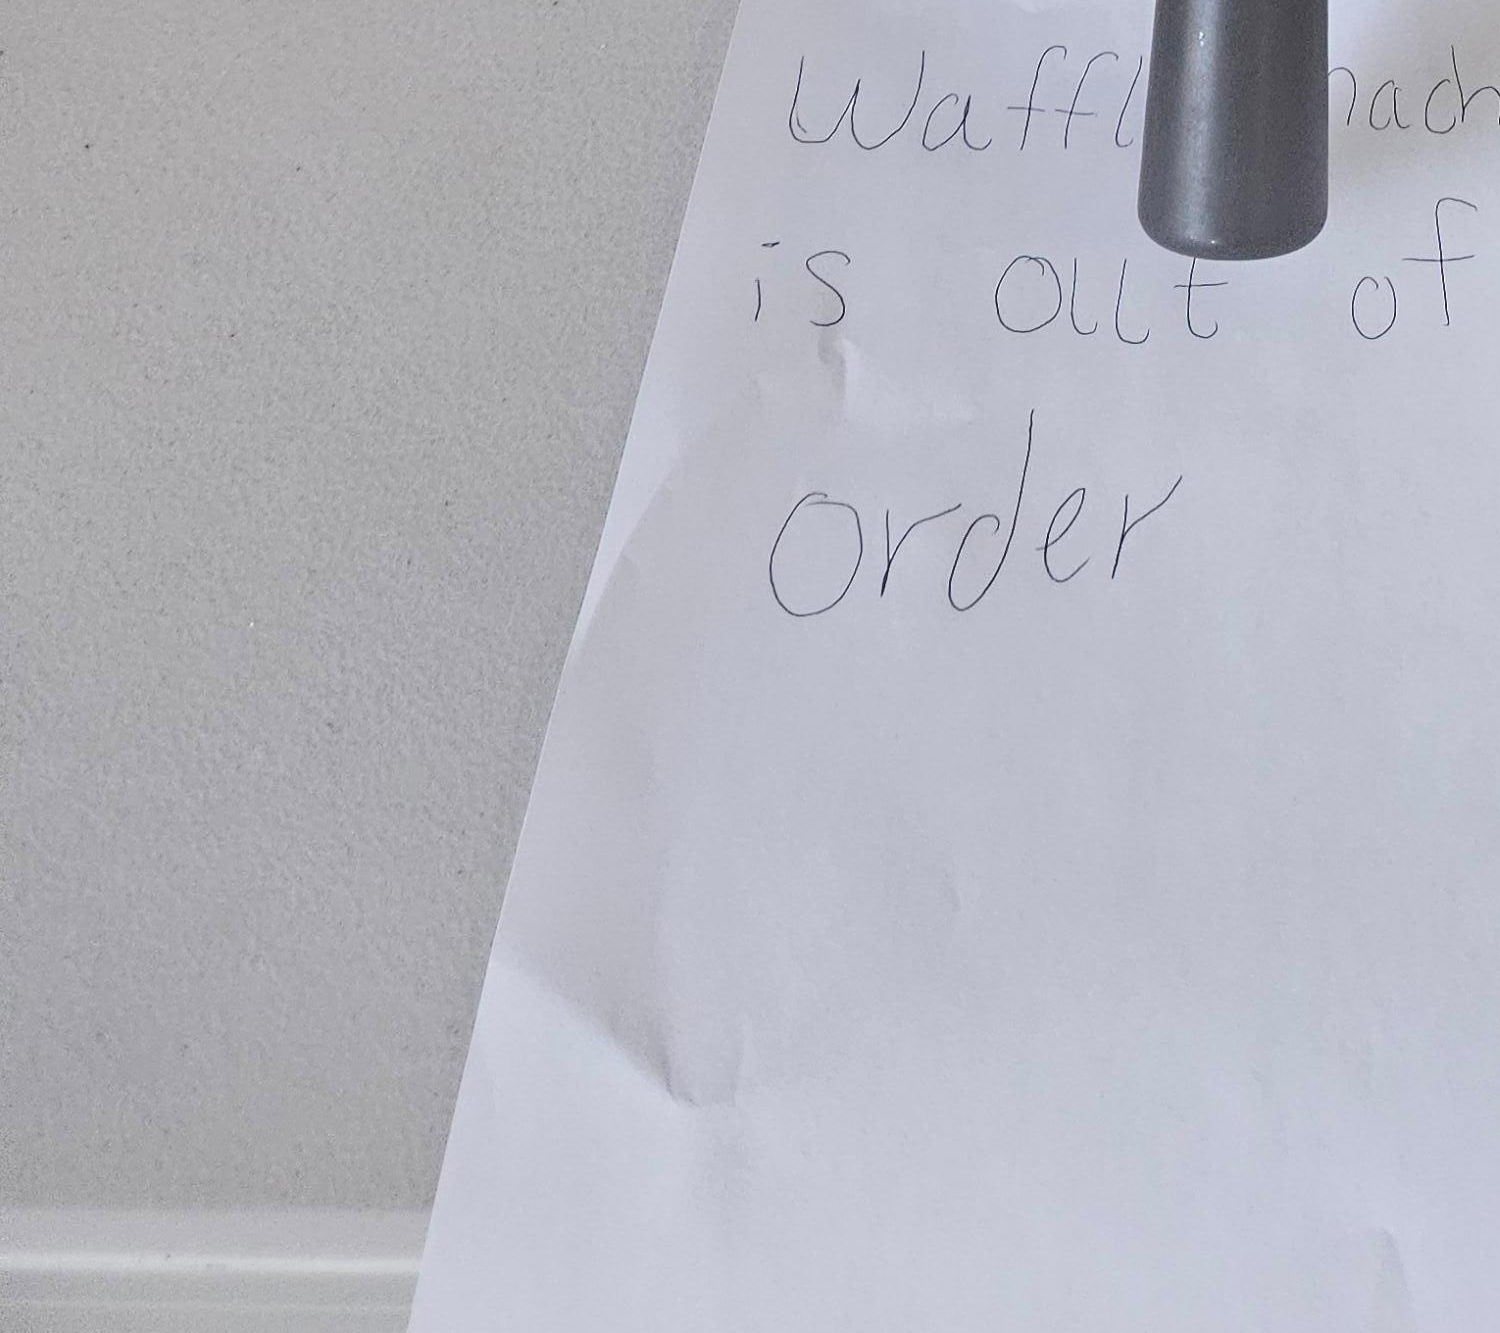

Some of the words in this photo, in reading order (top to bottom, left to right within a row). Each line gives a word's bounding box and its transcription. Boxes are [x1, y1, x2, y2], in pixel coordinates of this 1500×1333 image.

[788, 44, 1145, 151] Waffl
[750, 241, 851, 327] is
[994, 254, 1229, 345] out
[1350, 196, 1478, 340] of
